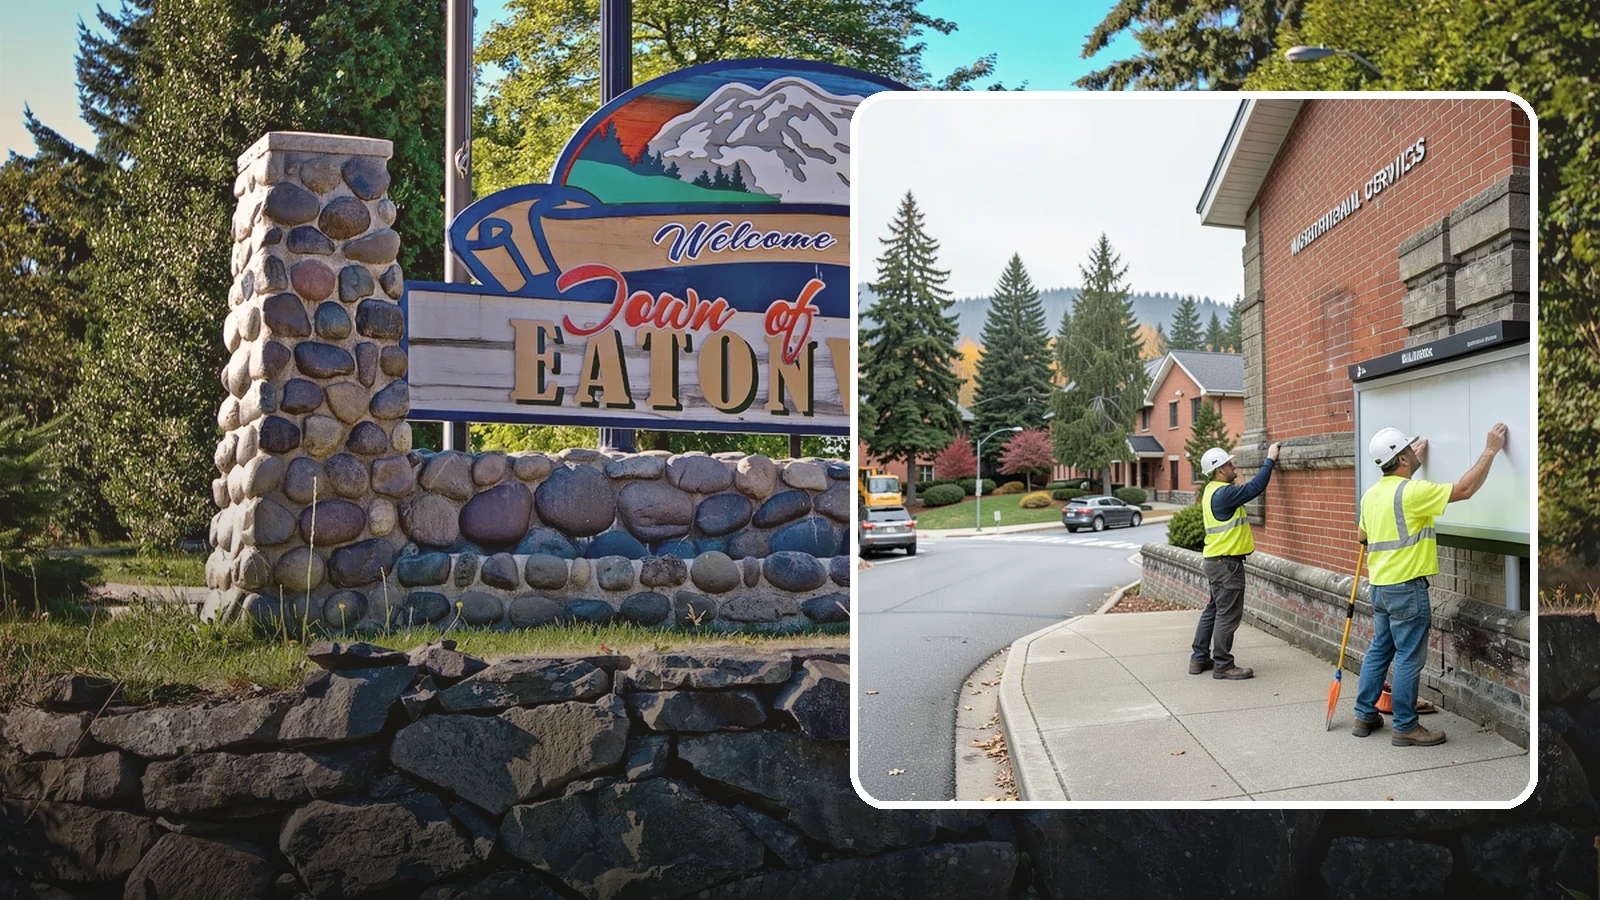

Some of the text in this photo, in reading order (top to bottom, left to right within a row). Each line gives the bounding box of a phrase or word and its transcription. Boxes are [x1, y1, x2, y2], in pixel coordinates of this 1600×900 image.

[653, 220, 838, 263] Welcome
[556, 263, 825, 365] Town of
